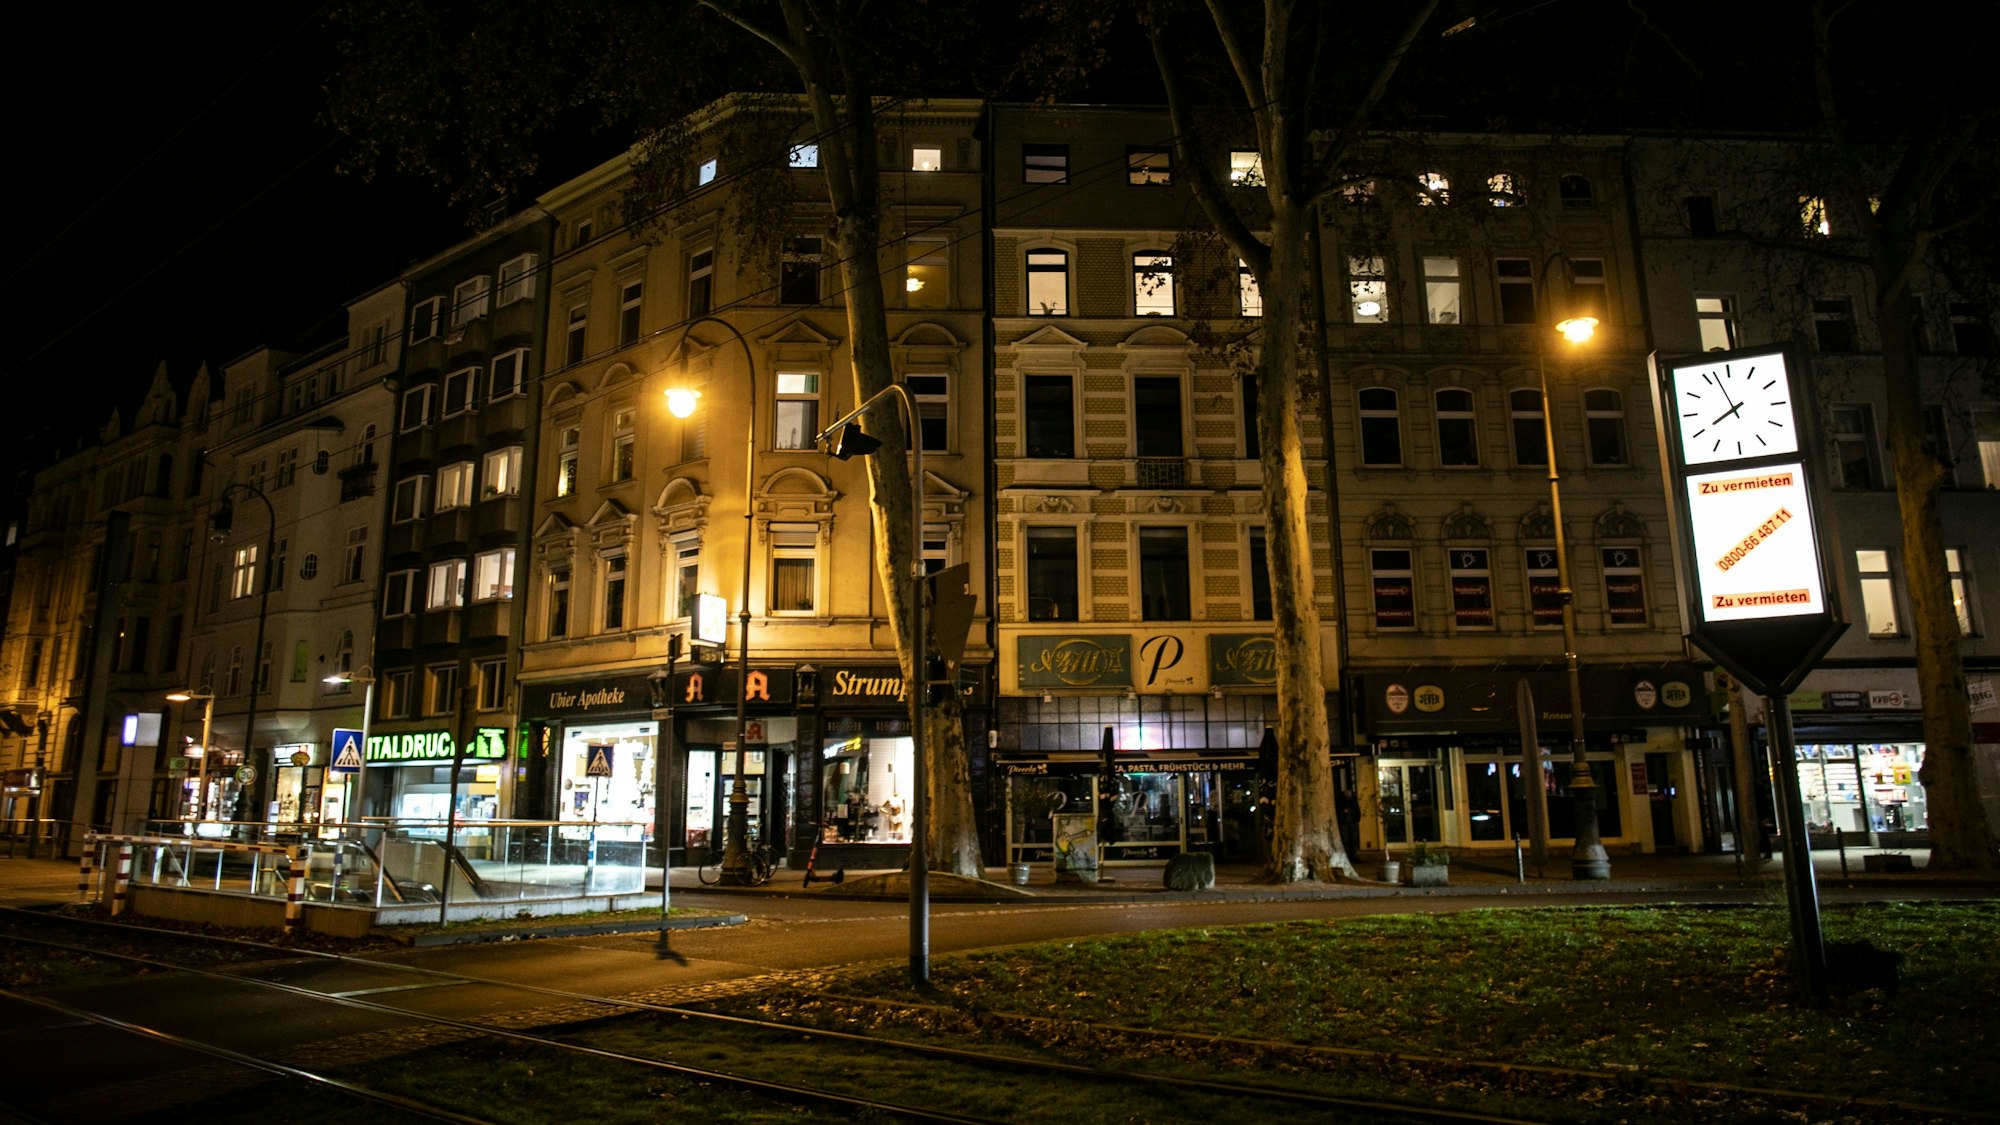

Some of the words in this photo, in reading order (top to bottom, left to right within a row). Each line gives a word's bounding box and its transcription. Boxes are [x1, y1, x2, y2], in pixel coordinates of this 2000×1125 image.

[1701, 483, 1718, 494] Zu
[1723, 476, 1791, 491] vermieten
[1718, 536, 1759, 571] 0800-66
[1757, 520, 1778, 539] 487
[1776, 509, 1792, 525] 11
[1716, 596, 1733, 607] Zu
[1737, 592, 1807, 605] vermieten
[550, 691, 576, 709] Ubier
[577, 687, 625, 710] Apotheke
[241, 769, 252, 780] 30
[1128, 764, 1157, 773] PASTA,
[1159, 762, 1210, 772] FRÜHSTÜCK
[1212, 763, 1219, 771] &
[1220, 762, 1245, 771] MEHR
